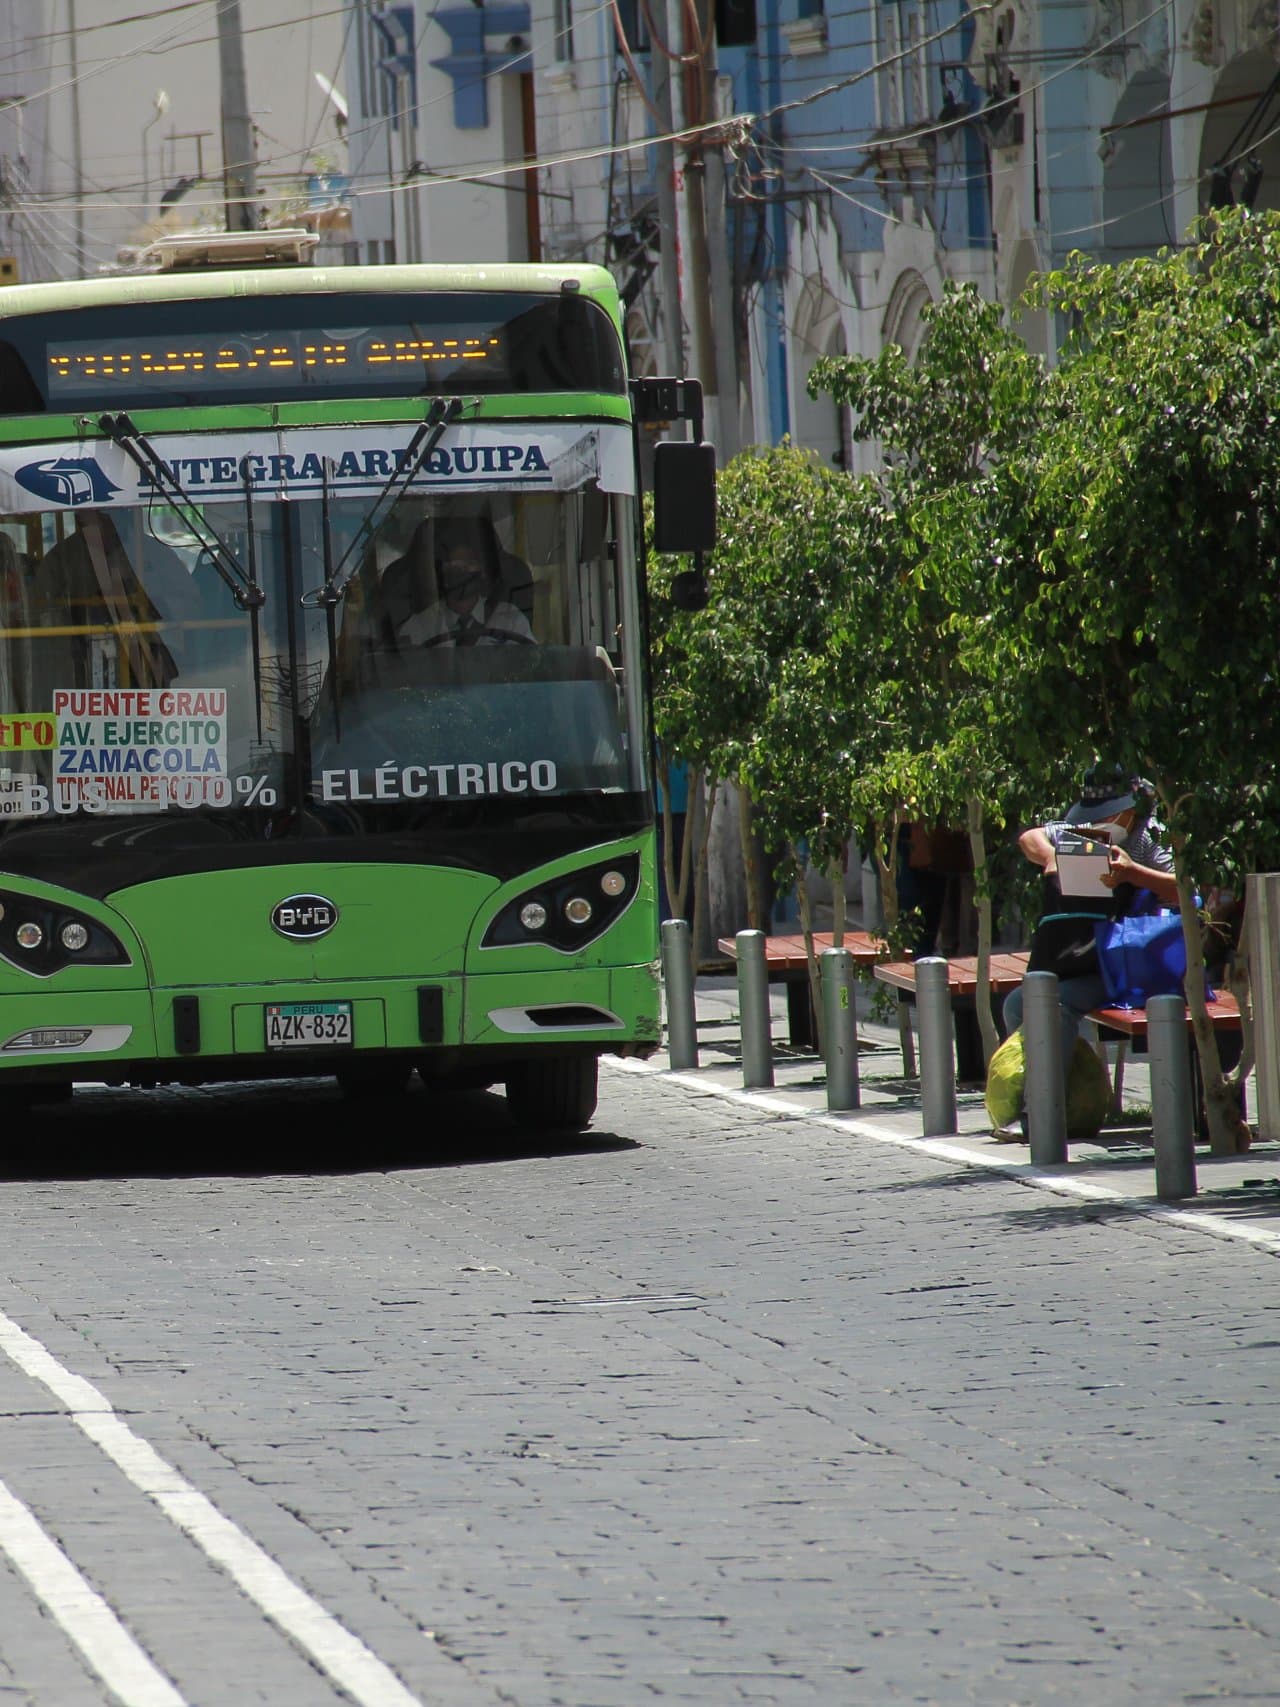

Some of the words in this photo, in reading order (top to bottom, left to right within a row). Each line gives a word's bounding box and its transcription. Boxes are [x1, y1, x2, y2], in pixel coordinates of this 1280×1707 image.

[137, 452, 326, 487] INTEGRA
[335, 445, 550, 479] AREQUIPA
[55, 691, 151, 717] PUENTE
[158, 691, 226, 717] GRAU
[59, 720, 95, 746] AV.
[103, 720, 221, 746] EJERCITO
[58, 747, 222, 774] ZAMACOLA
[23, 783, 108, 816] BUS
[158, 774, 277, 810] 100%
[322, 759, 558, 801] ELÉCTRICO
[279, 907, 330, 927] BYD
[271, 1014, 348, 1040] AZK-832
